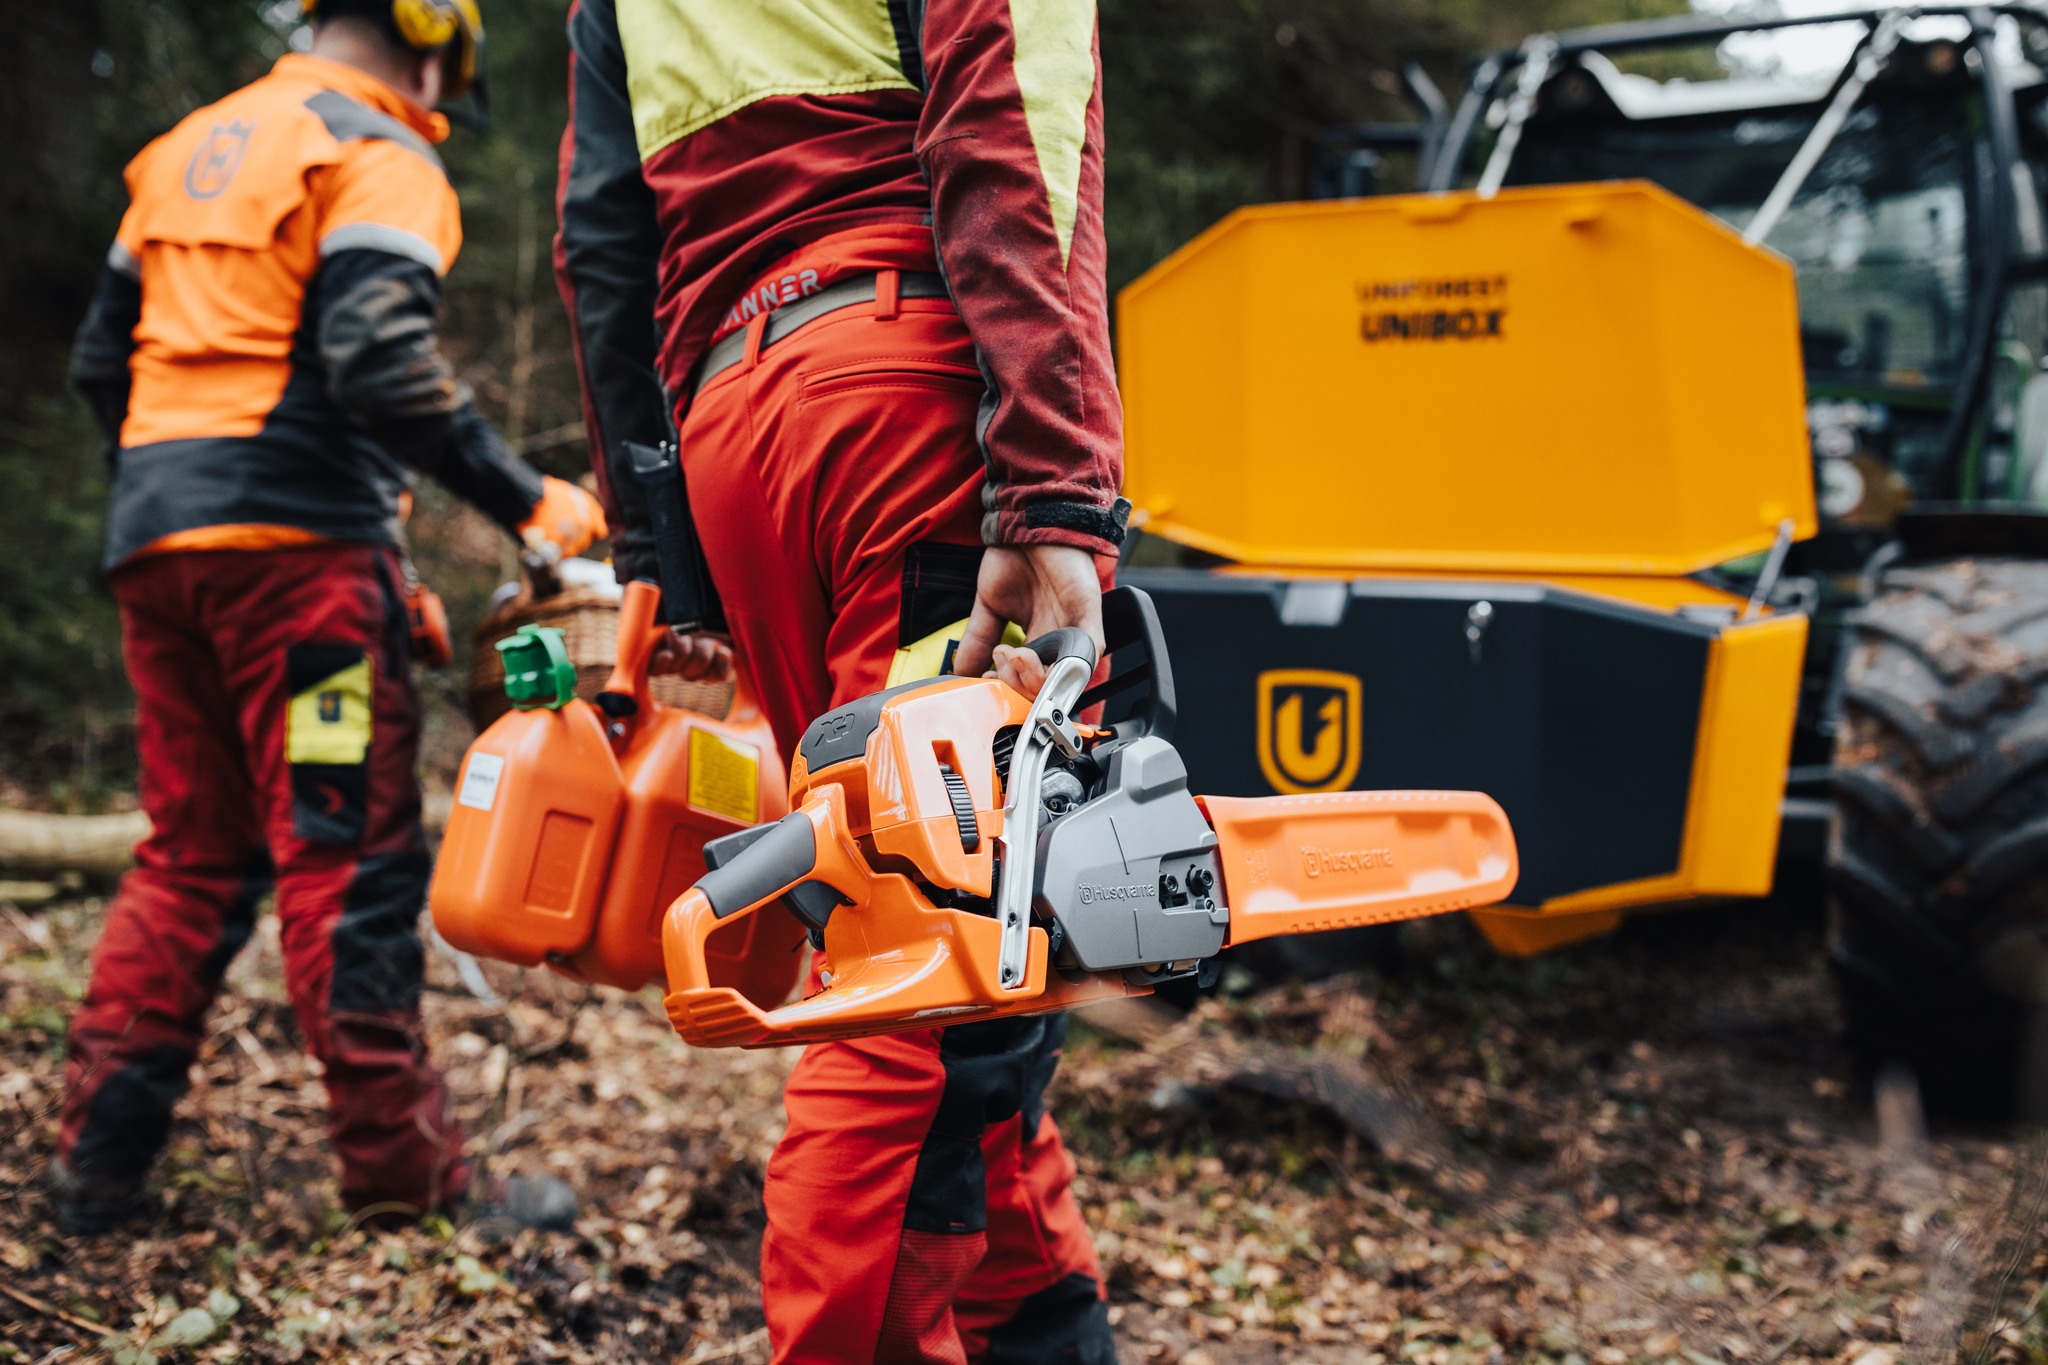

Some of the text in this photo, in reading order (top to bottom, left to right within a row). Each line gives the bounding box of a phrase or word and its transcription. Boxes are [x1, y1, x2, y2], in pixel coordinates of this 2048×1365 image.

[712, 269, 822, 338] ANNER
[1361, 309, 1506, 342] UNIBOX
[1318, 847, 1394, 876] Husqvarna
[1093, 883, 1156, 902] Husqvarna
